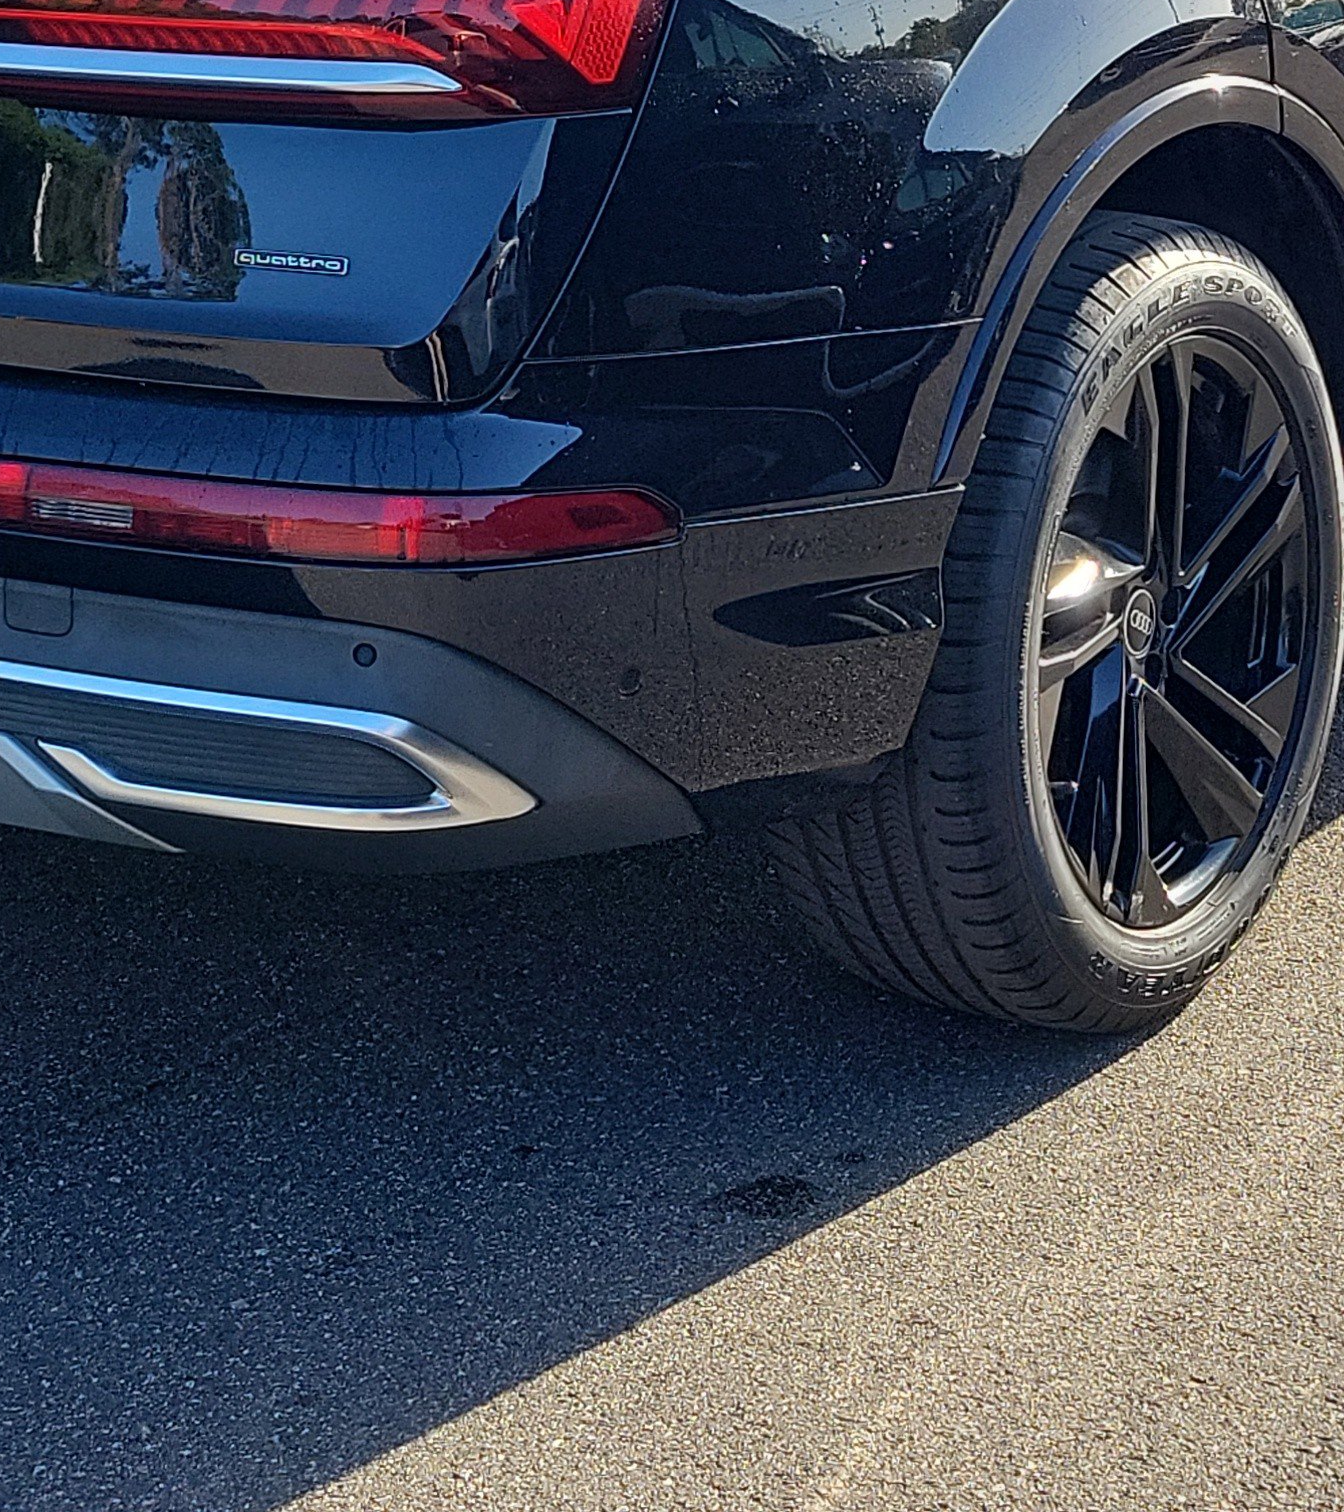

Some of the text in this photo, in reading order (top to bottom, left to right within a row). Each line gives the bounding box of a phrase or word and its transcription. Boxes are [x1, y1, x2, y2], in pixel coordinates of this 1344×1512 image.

[239, 253, 341, 270] quattro
[1082, 275, 1298, 417] EAGLE SPORT
